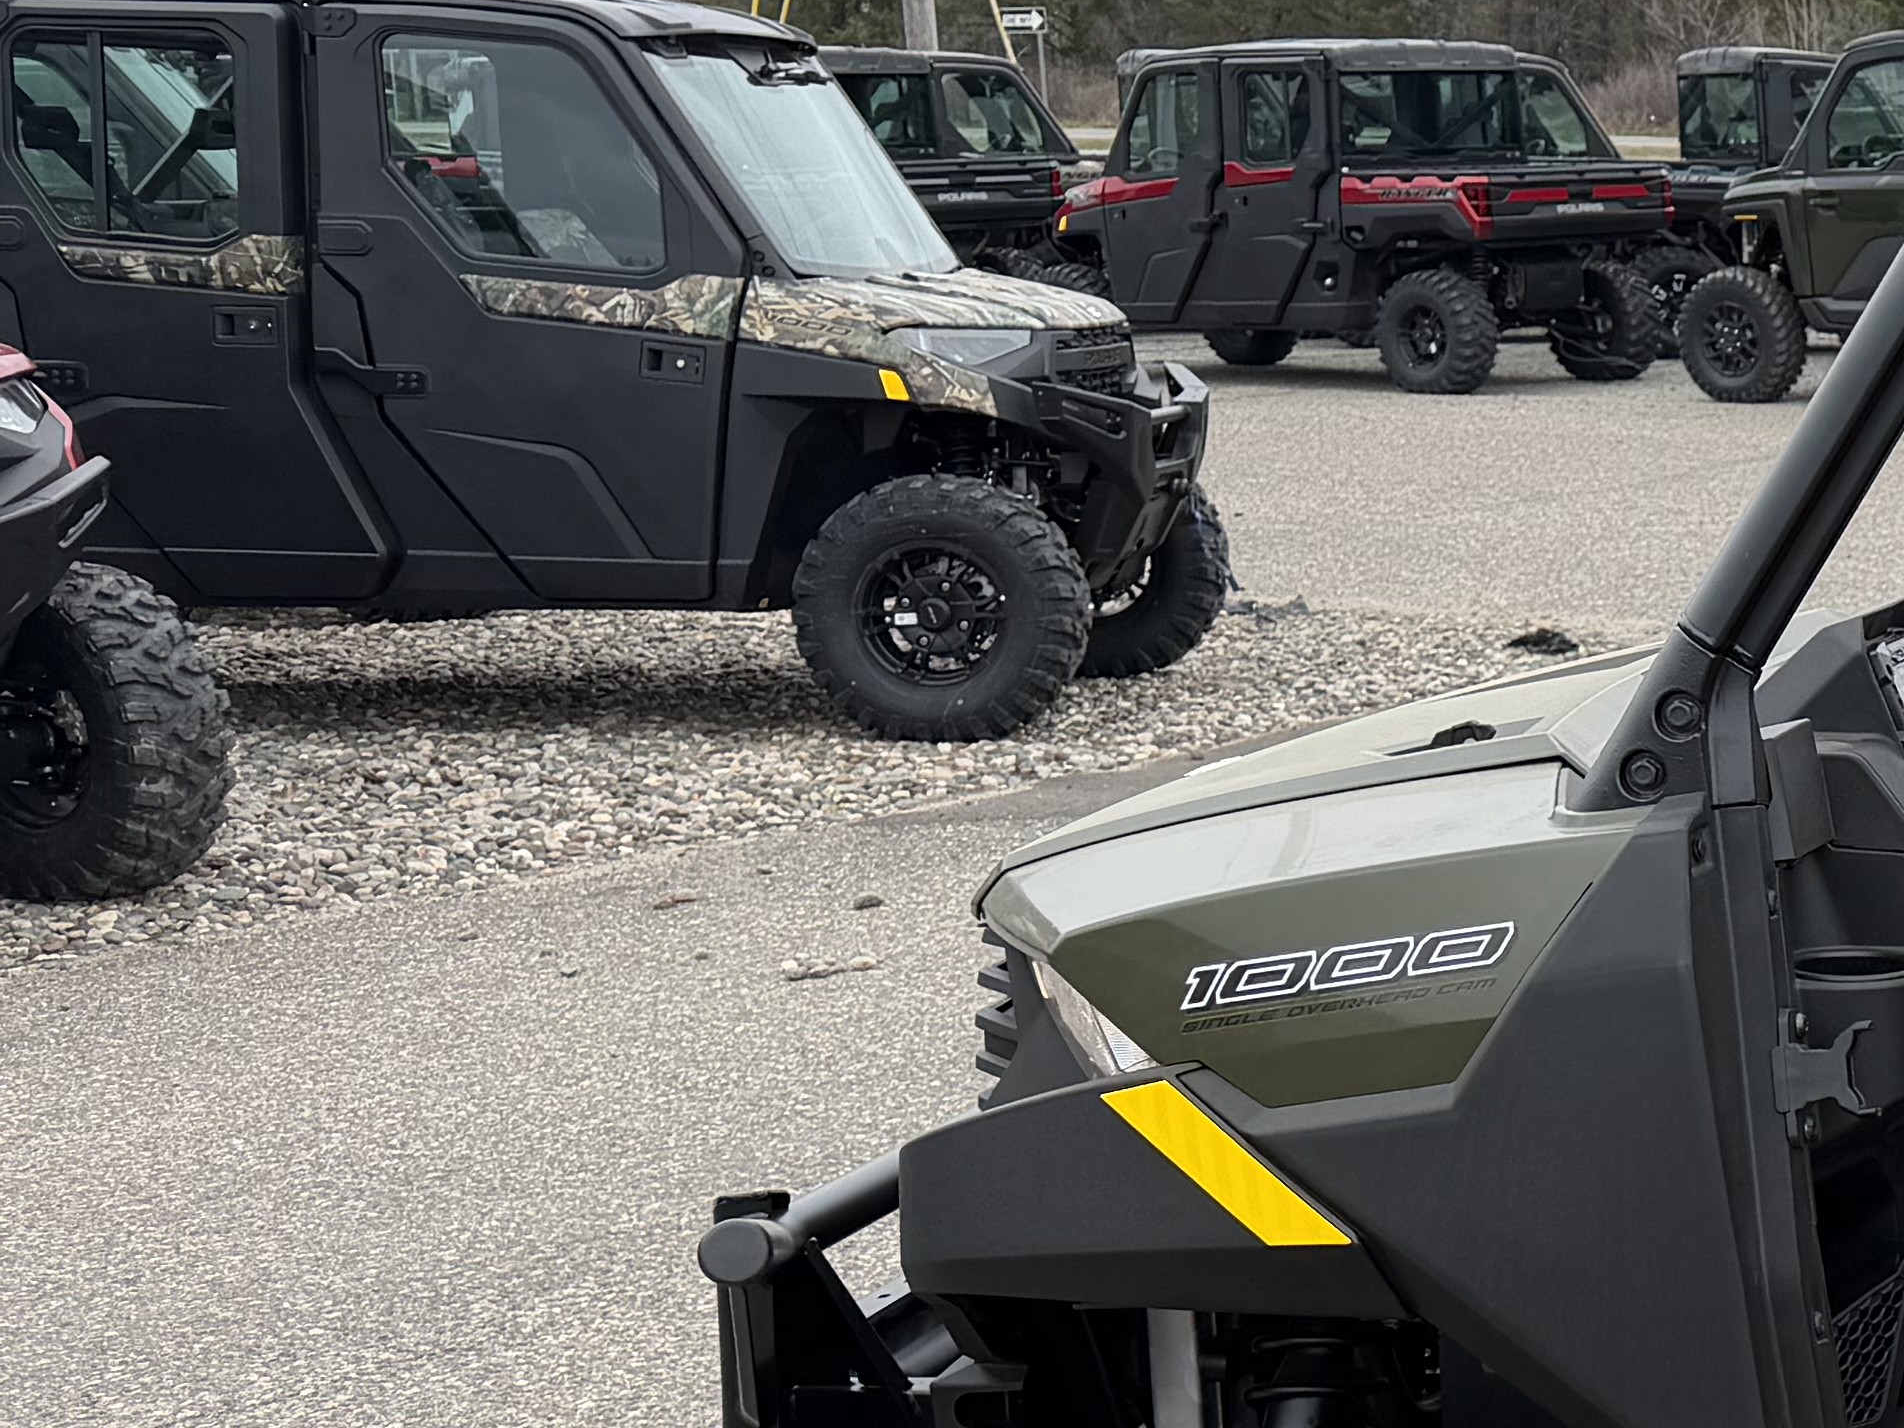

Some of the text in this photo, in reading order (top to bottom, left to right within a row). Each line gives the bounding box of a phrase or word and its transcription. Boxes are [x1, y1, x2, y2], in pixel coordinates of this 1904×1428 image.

[937, 191, 989, 203] POLARIS
[1556, 202, 1605, 214] POLARIS
[1179, 920, 1516, 1011] 1000
[1180, 976, 1498, 1035] SINGLE OVERHEAD CAM
